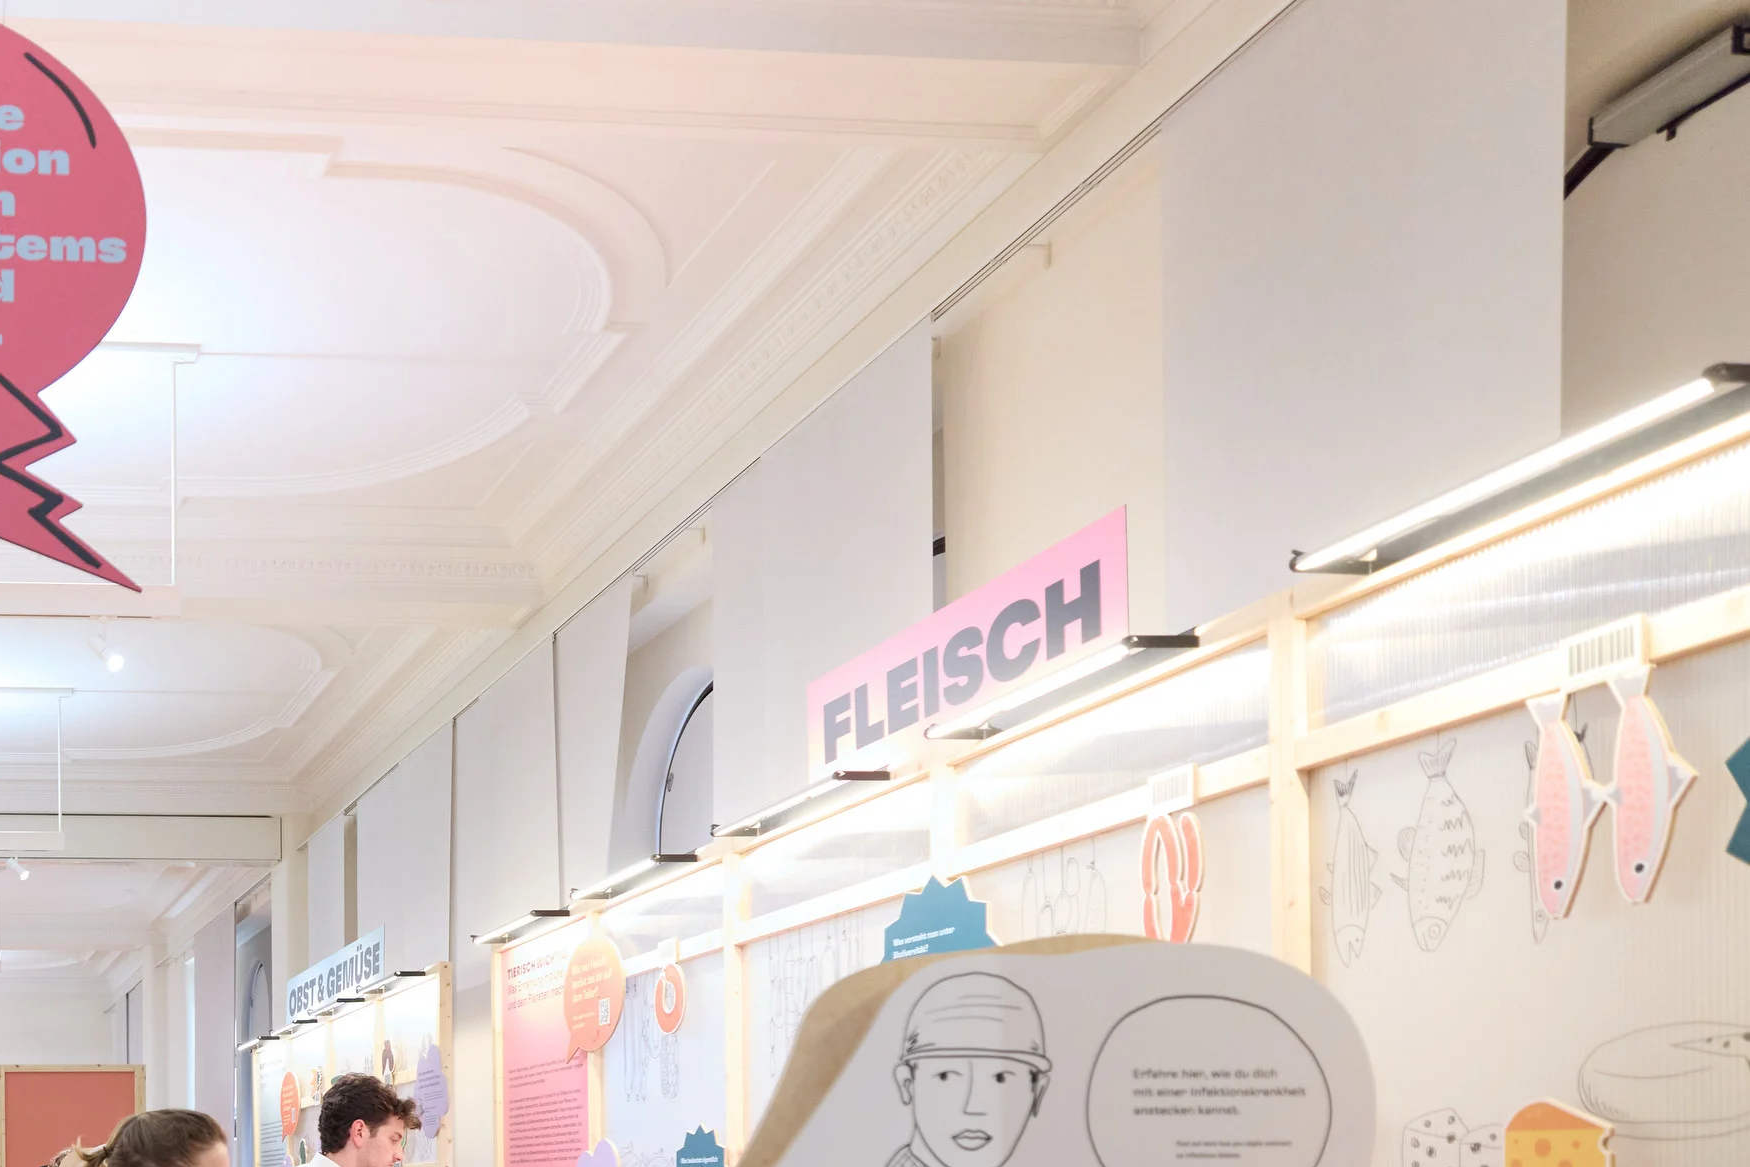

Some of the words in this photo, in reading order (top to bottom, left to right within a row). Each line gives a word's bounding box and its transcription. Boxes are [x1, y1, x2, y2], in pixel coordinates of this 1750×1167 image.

[823, 559, 1102, 765] FLEISCH
[289, 977, 316, 1016] OBST
[317, 973, 325, 1003] &
[327, 941, 380, 998] GEMÜSE
